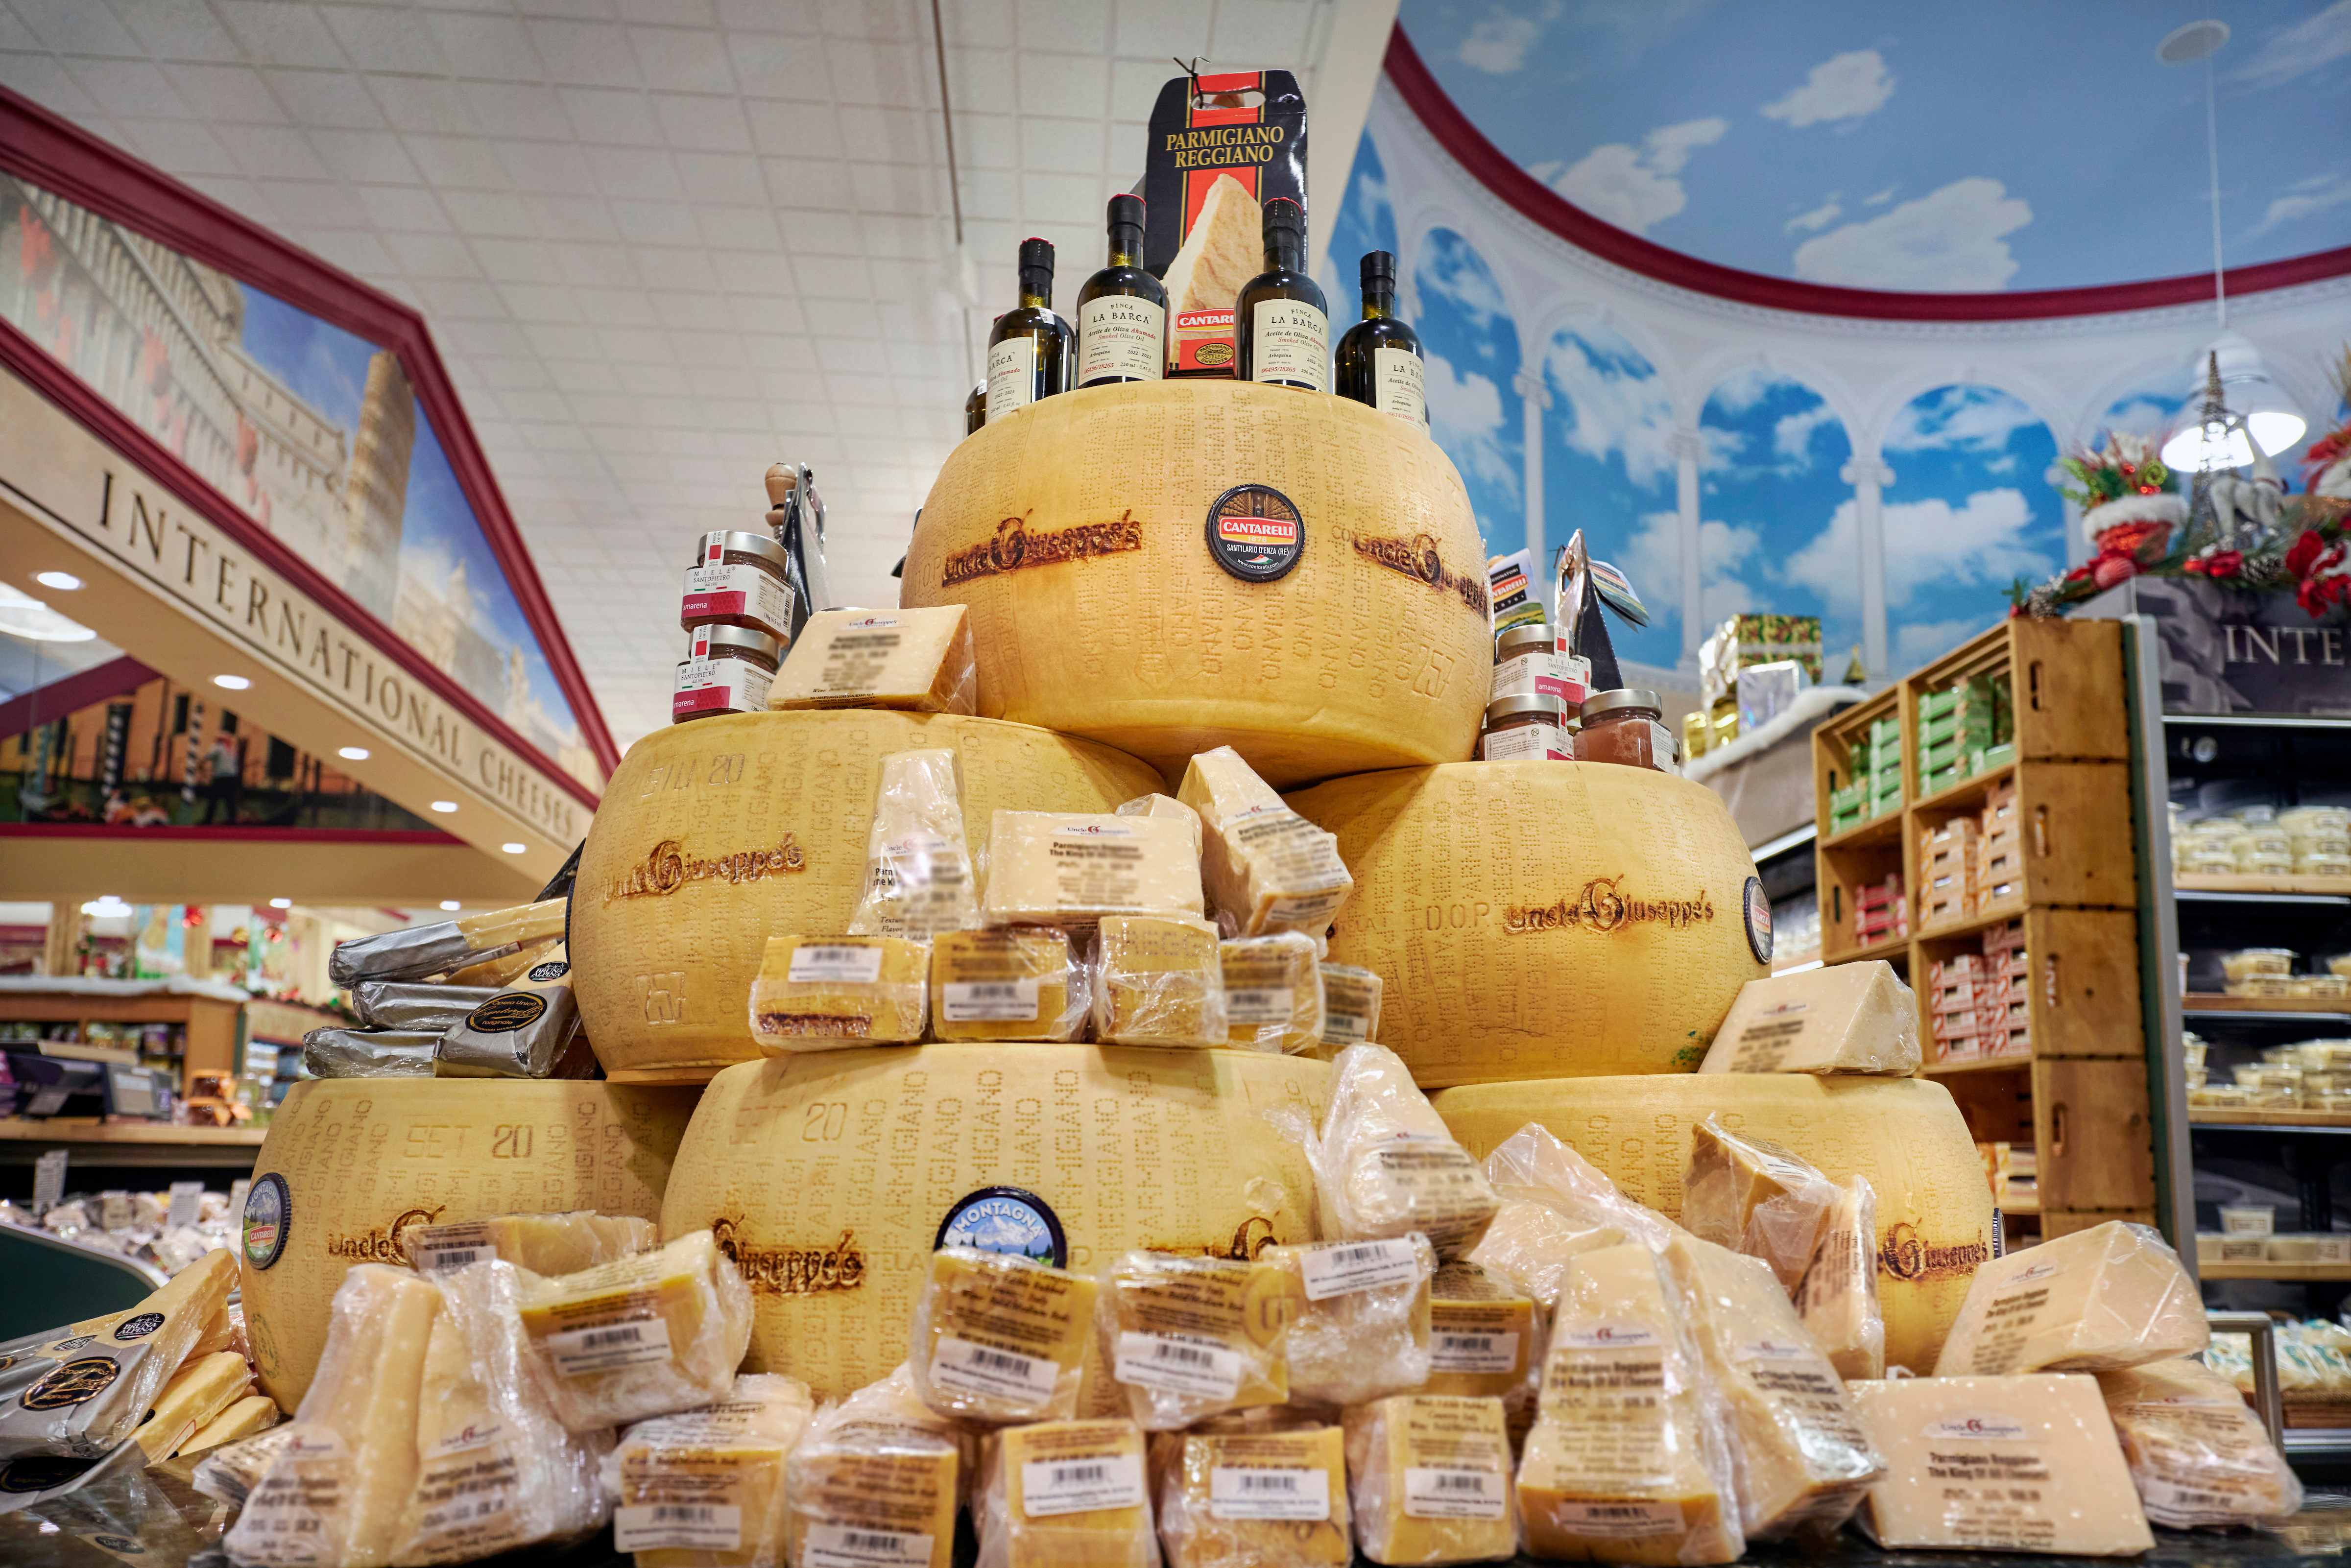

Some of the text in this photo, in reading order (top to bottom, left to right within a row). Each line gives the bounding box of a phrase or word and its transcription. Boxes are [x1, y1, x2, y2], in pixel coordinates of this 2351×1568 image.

[1166, 126, 1284, 151] PARMIGIANO
[1175, 145, 1273, 168] REGGIANO
[1093, 312, 1149, 324] LA BARCA
[1179, 315, 1234, 326] CANTAR
[1291, 309, 1311, 318] FINCA
[1293, 317, 1323, 335] BARCA
[1088, 329, 1103, 337] Aceite
[1131, 328, 1156, 340] Ahumado
[1294, 332, 1308, 340] Oliva
[1309, 337, 1326, 352] Ahumado
[997, 368, 1020, 378] Ahumado
[1400, 385, 1415, 394] Smoked
[1223, 522, 1293, 536] CANTARELLI
[1227, 544, 1257, 553] SANT'ILARIO
[1259, 546, 1276, 555] D'ENZA
[1237, 558, 1279, 570] www.cantarelli.com
[694, 568, 731, 576] MIELE
[1492, 576, 1527, 598] NTARELLI
[683, 602, 707, 610] amarena
[2223, 624, 2351, 667] INTE
[100, 468, 573, 838] INTERNATIONAL CHEESES
[682, 664, 716, 674] MIELE
[1548, 657, 1577, 668] MIELE
[1548, 663, 1577, 674] SANTOPIETRO
[681, 670, 715, 680] SANTOPIETRO
[1538, 684, 1561, 693] amarena
[1503, 899, 1580, 935] Uncle
[801, 1102, 848, 1142] 20
[492, 1123, 533, 1159] 20
[1054, 1069, 1082, 1230] ARMIGIANO
[883, 1070, 928, 1249] PARMIGIANO
[1095, 1098, 1124, 1251] REGGIANO
[249, 1184, 279, 1208] MONTAGNA
[954, 1202, 1045, 1233] MONTAGNA
[251, 1230, 274, 1240] CANTARELLI
[328, 1229, 390, 1262] Uncle
